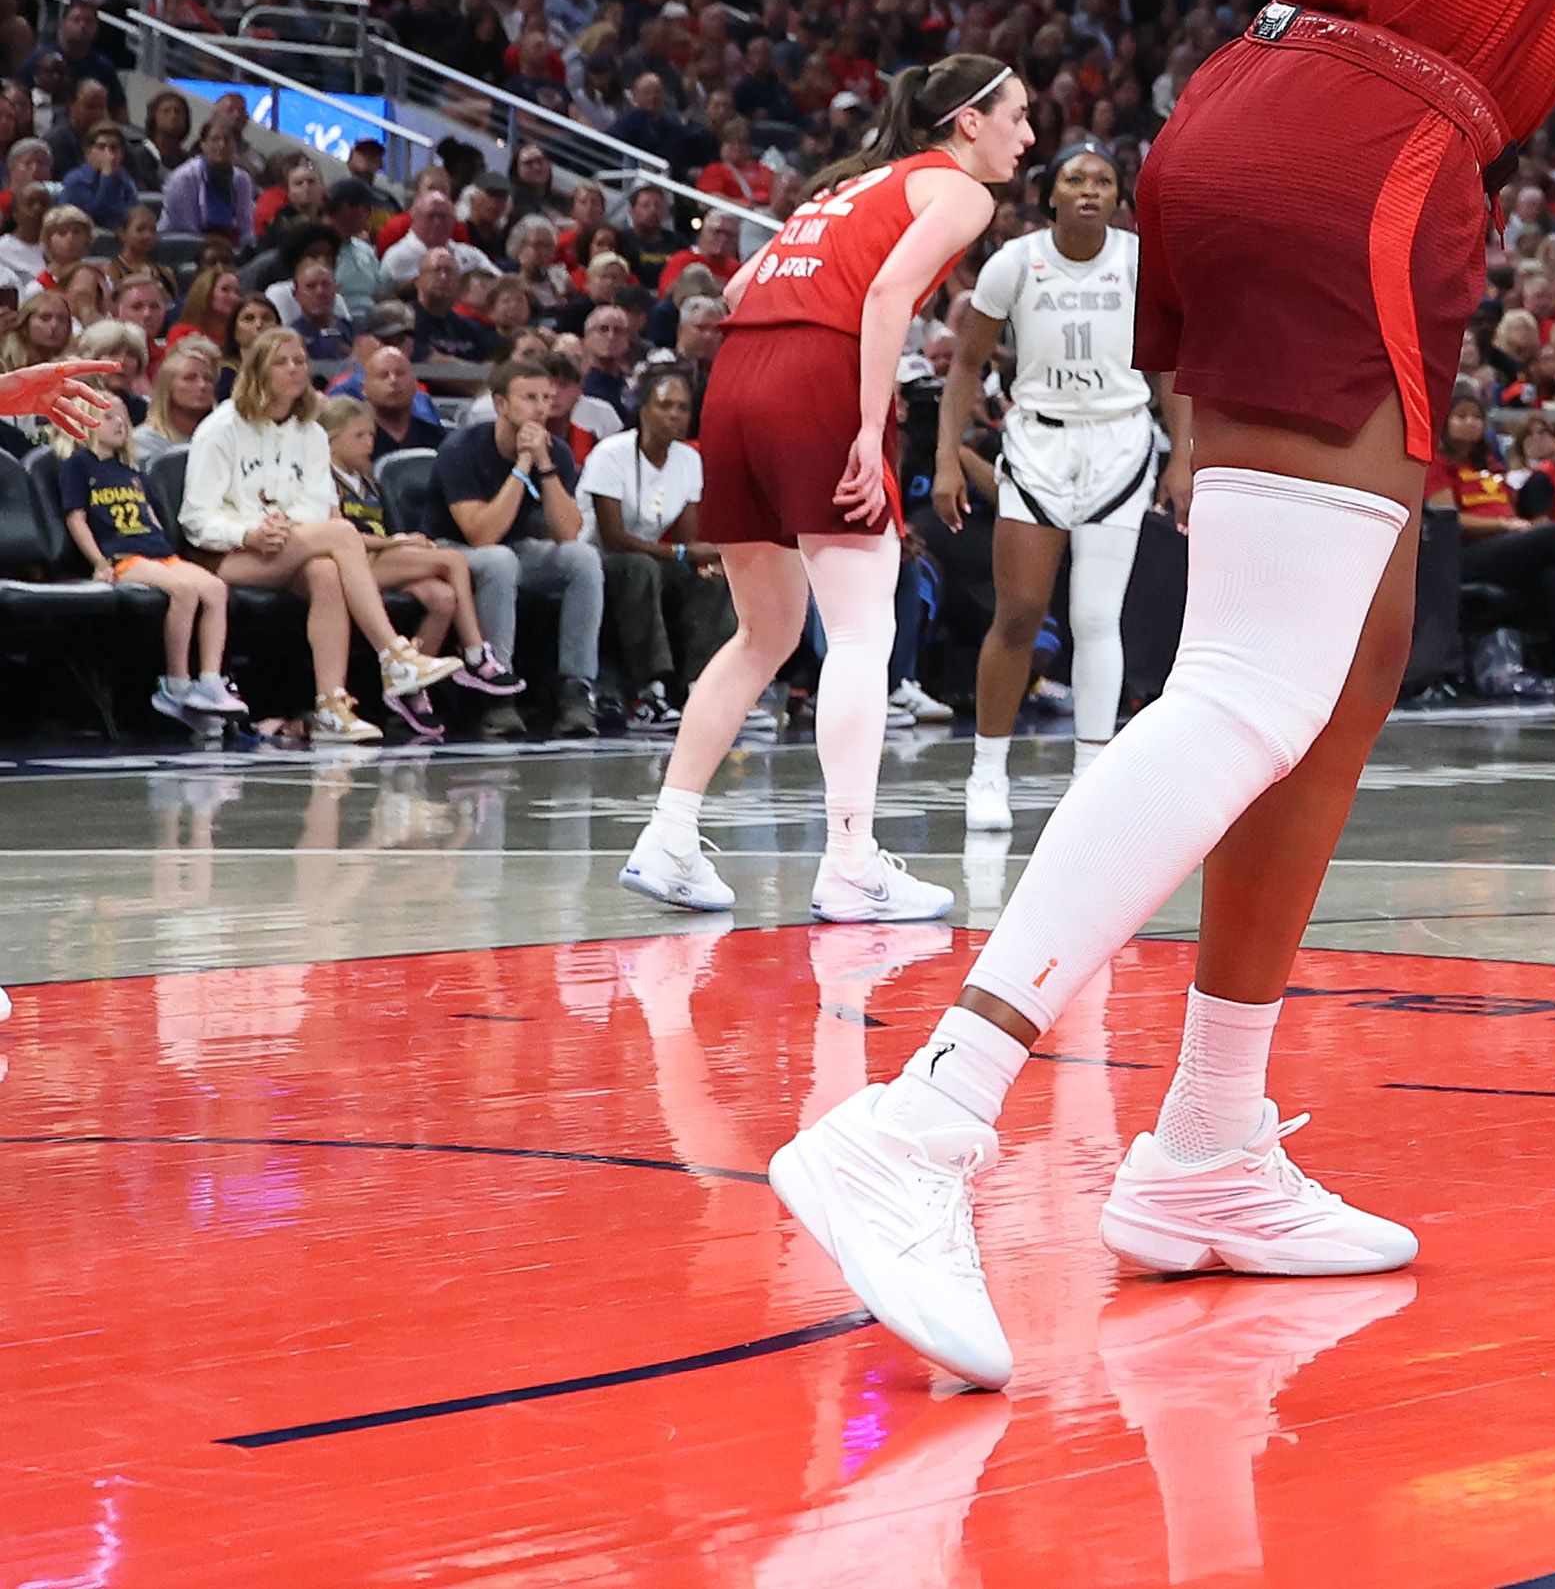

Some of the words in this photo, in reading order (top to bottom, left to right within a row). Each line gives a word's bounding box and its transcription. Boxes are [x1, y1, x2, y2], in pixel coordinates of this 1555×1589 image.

[775, 256, 824, 278] AT&T
[1032, 291, 1122, 311] ACES
[1062, 321, 1093, 361] 11
[1045, 366, 1104, 391] IPSY
[109, 502, 143, 530] 22
